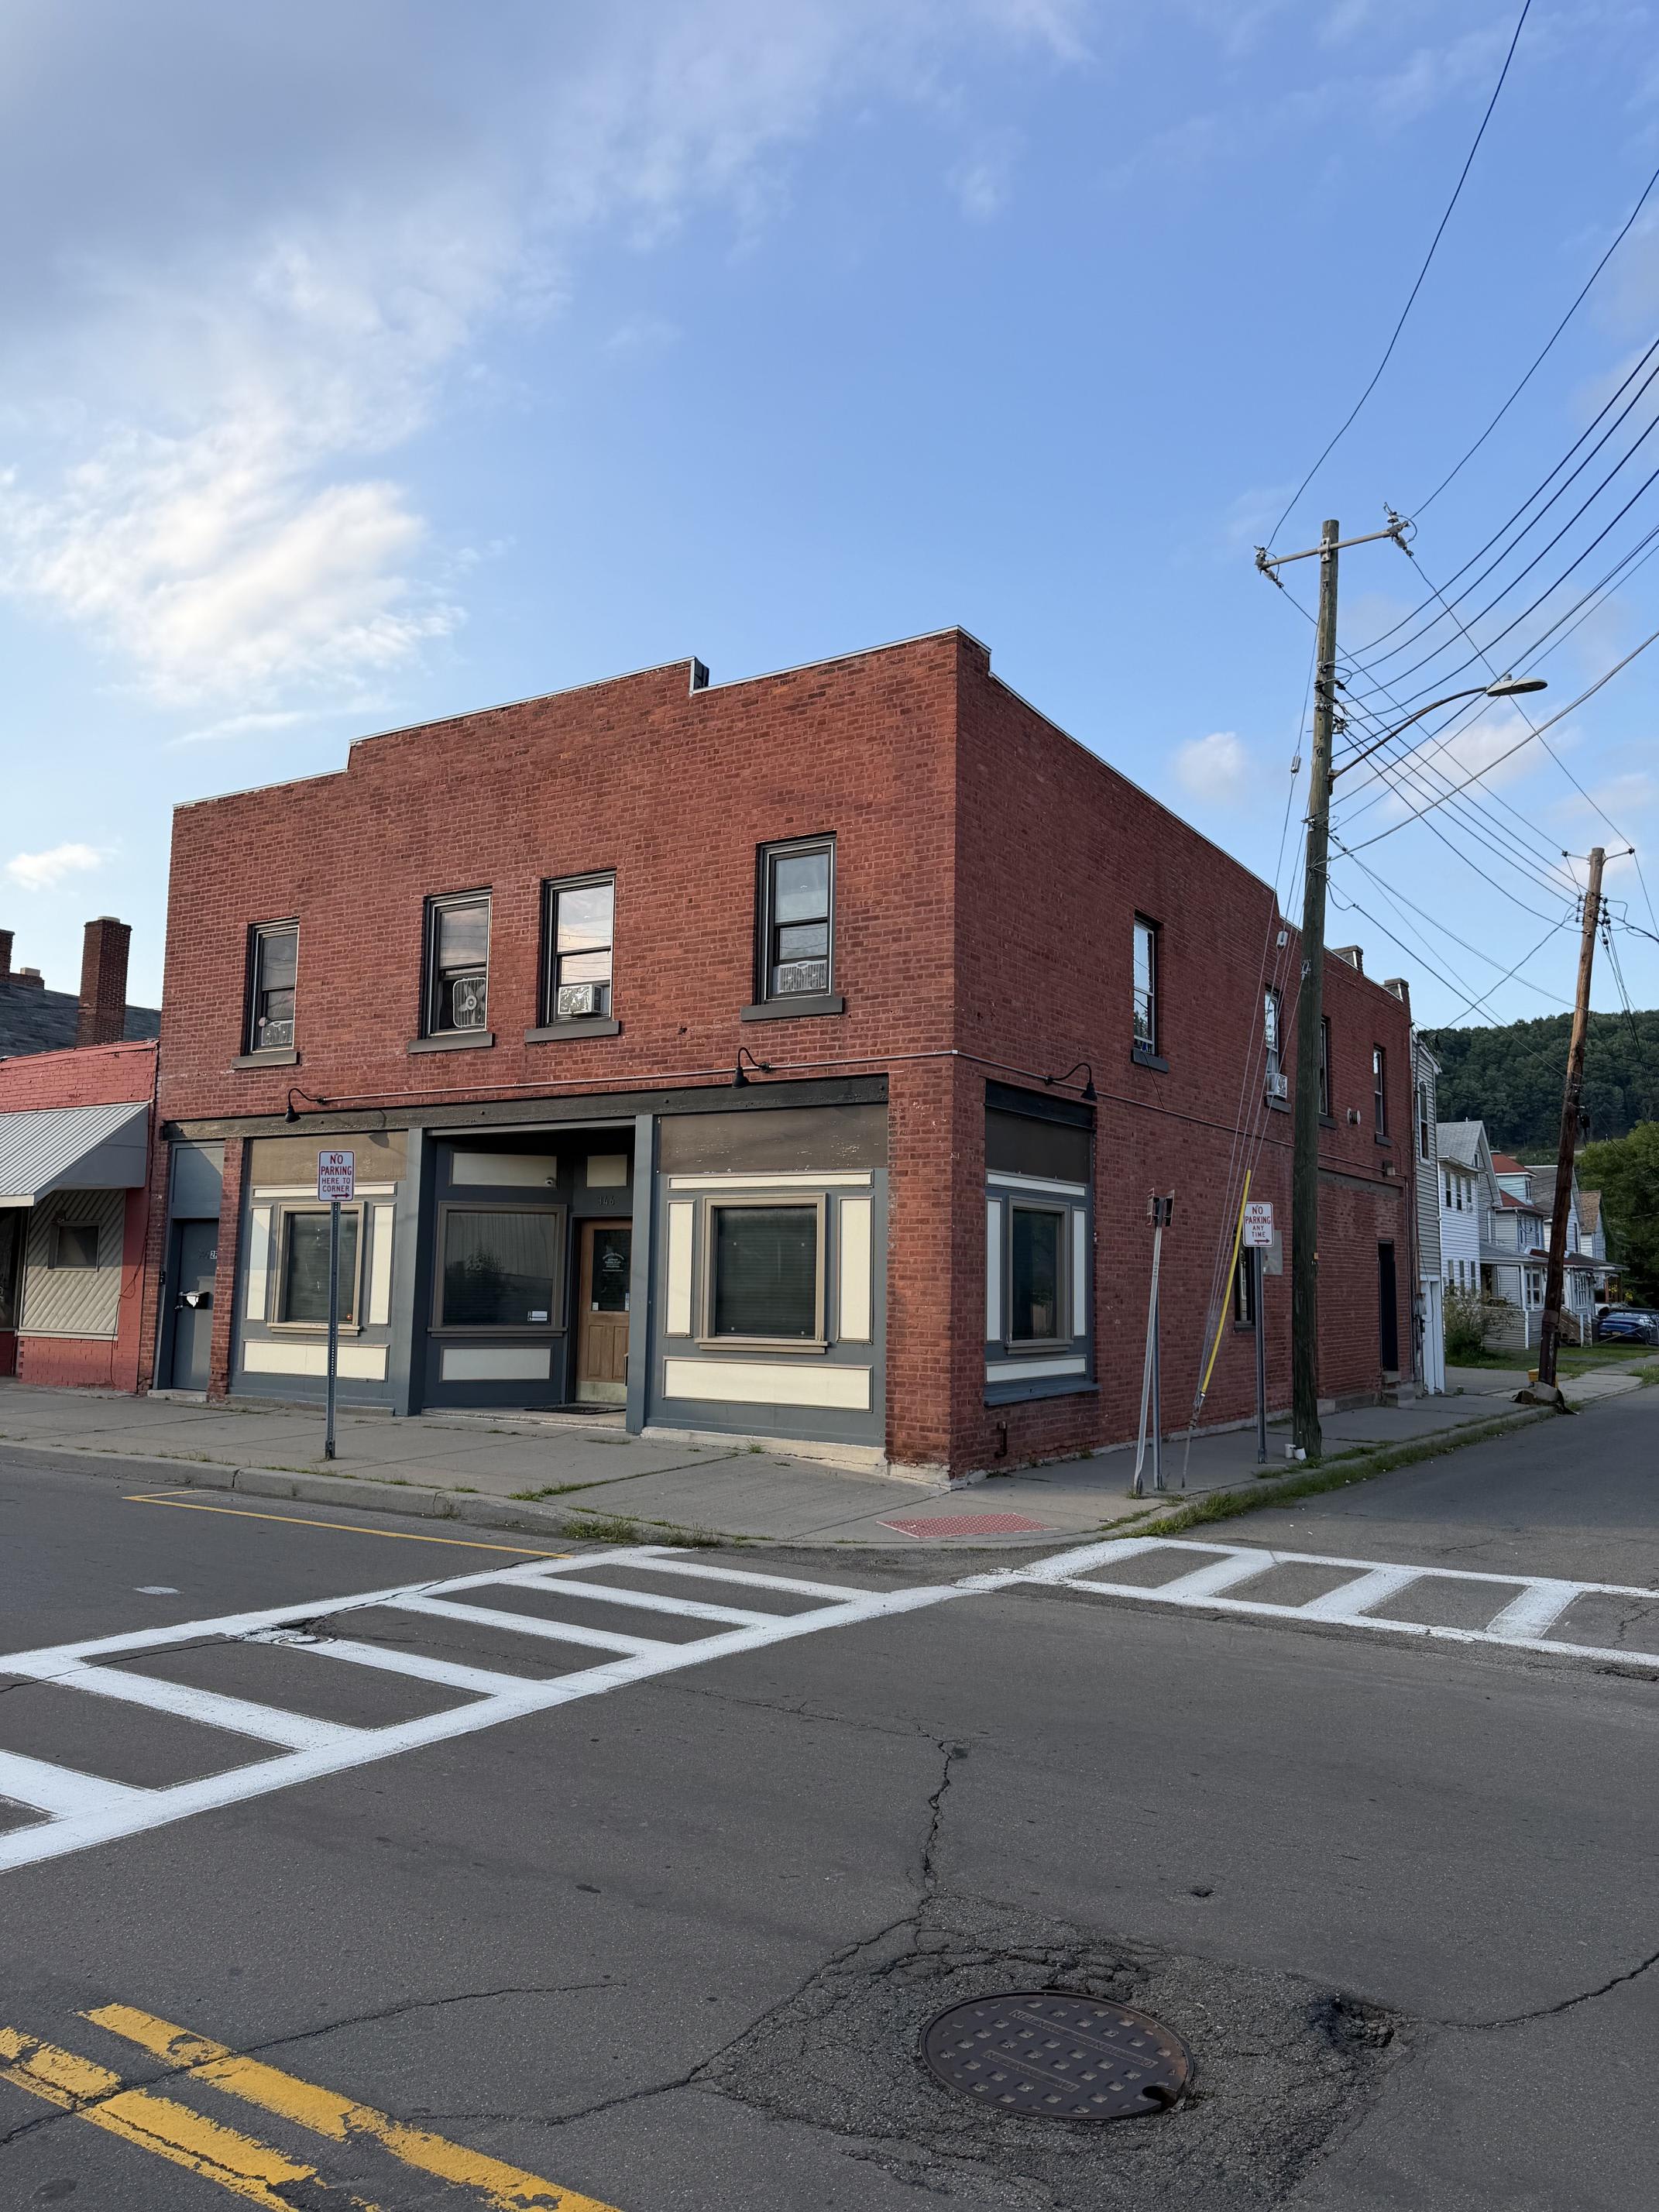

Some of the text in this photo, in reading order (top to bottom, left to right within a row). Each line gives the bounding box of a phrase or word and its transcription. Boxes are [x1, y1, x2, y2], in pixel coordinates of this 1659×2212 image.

[330, 1154, 343, 1164] NO
[321, 1166, 352, 1176] PARKING
[1252, 1206, 1263, 1214] NO
[1245, 1216, 1271, 1224] PARKING
